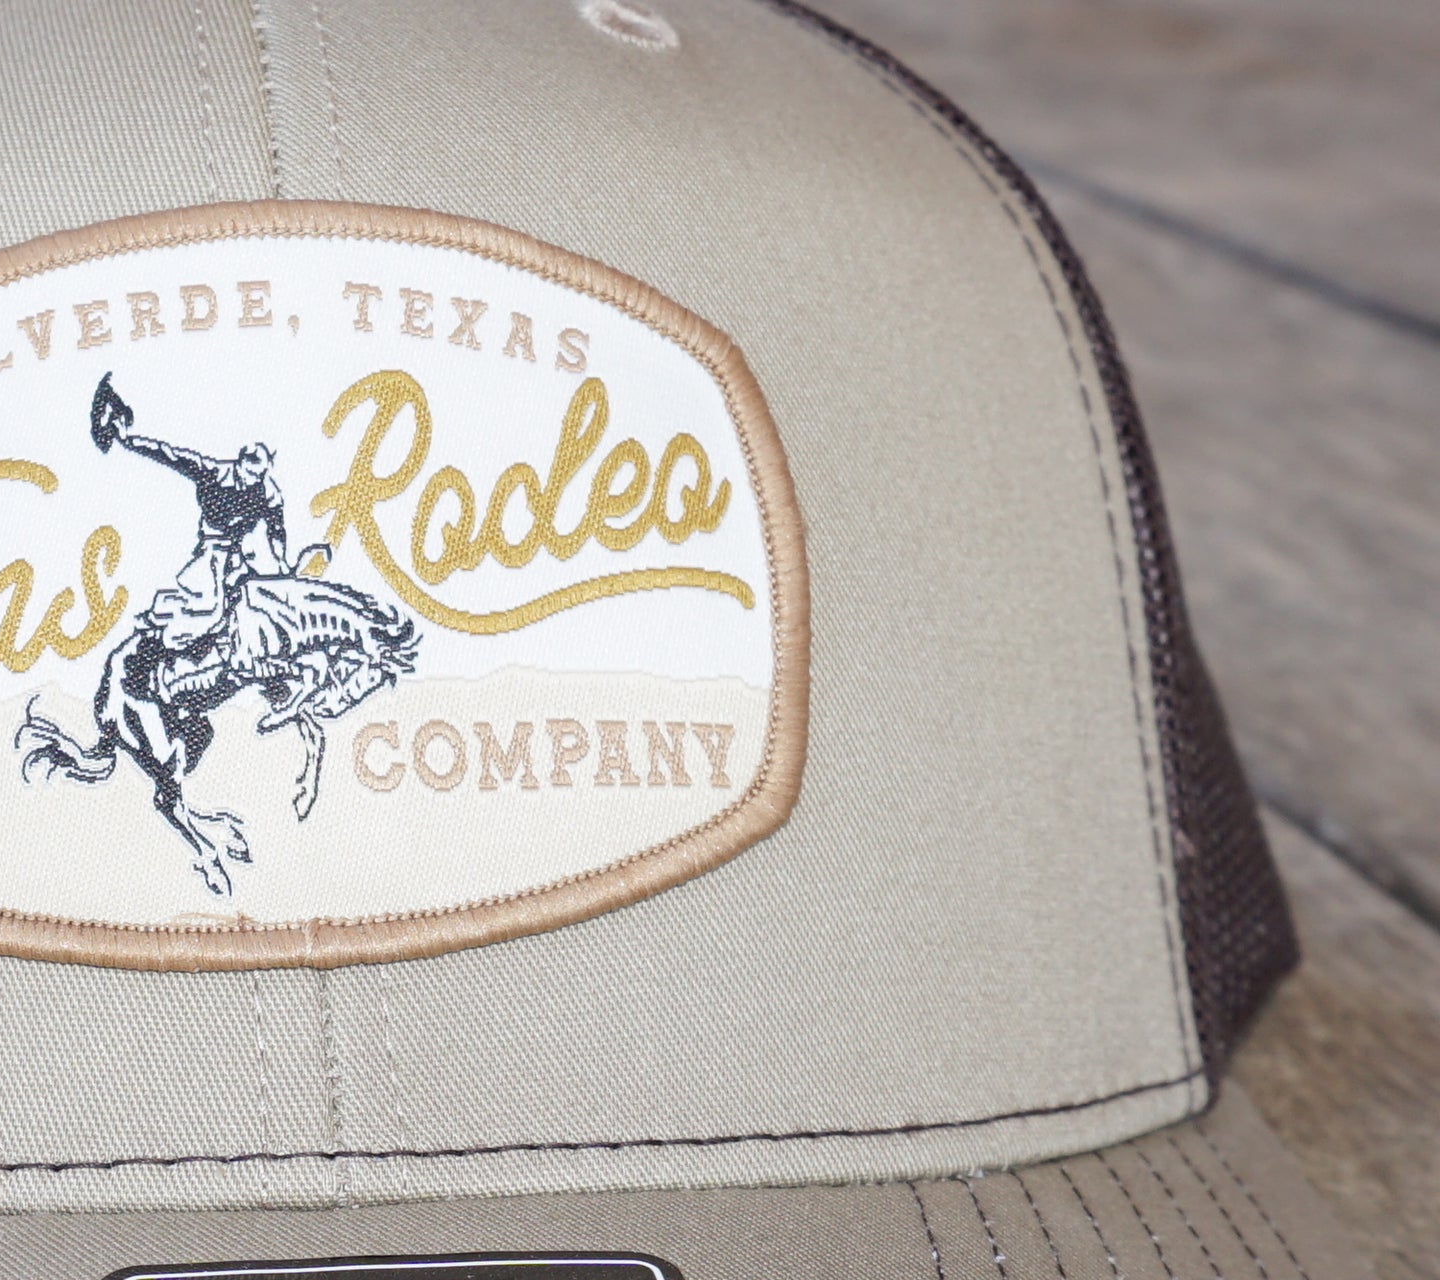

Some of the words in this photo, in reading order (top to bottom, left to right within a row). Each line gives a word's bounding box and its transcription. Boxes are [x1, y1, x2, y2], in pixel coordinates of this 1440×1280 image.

[343, 281, 593, 375] TEXAS
[309, 368, 756, 636] Rodeo
[352, 719, 737, 793] COMPANY
